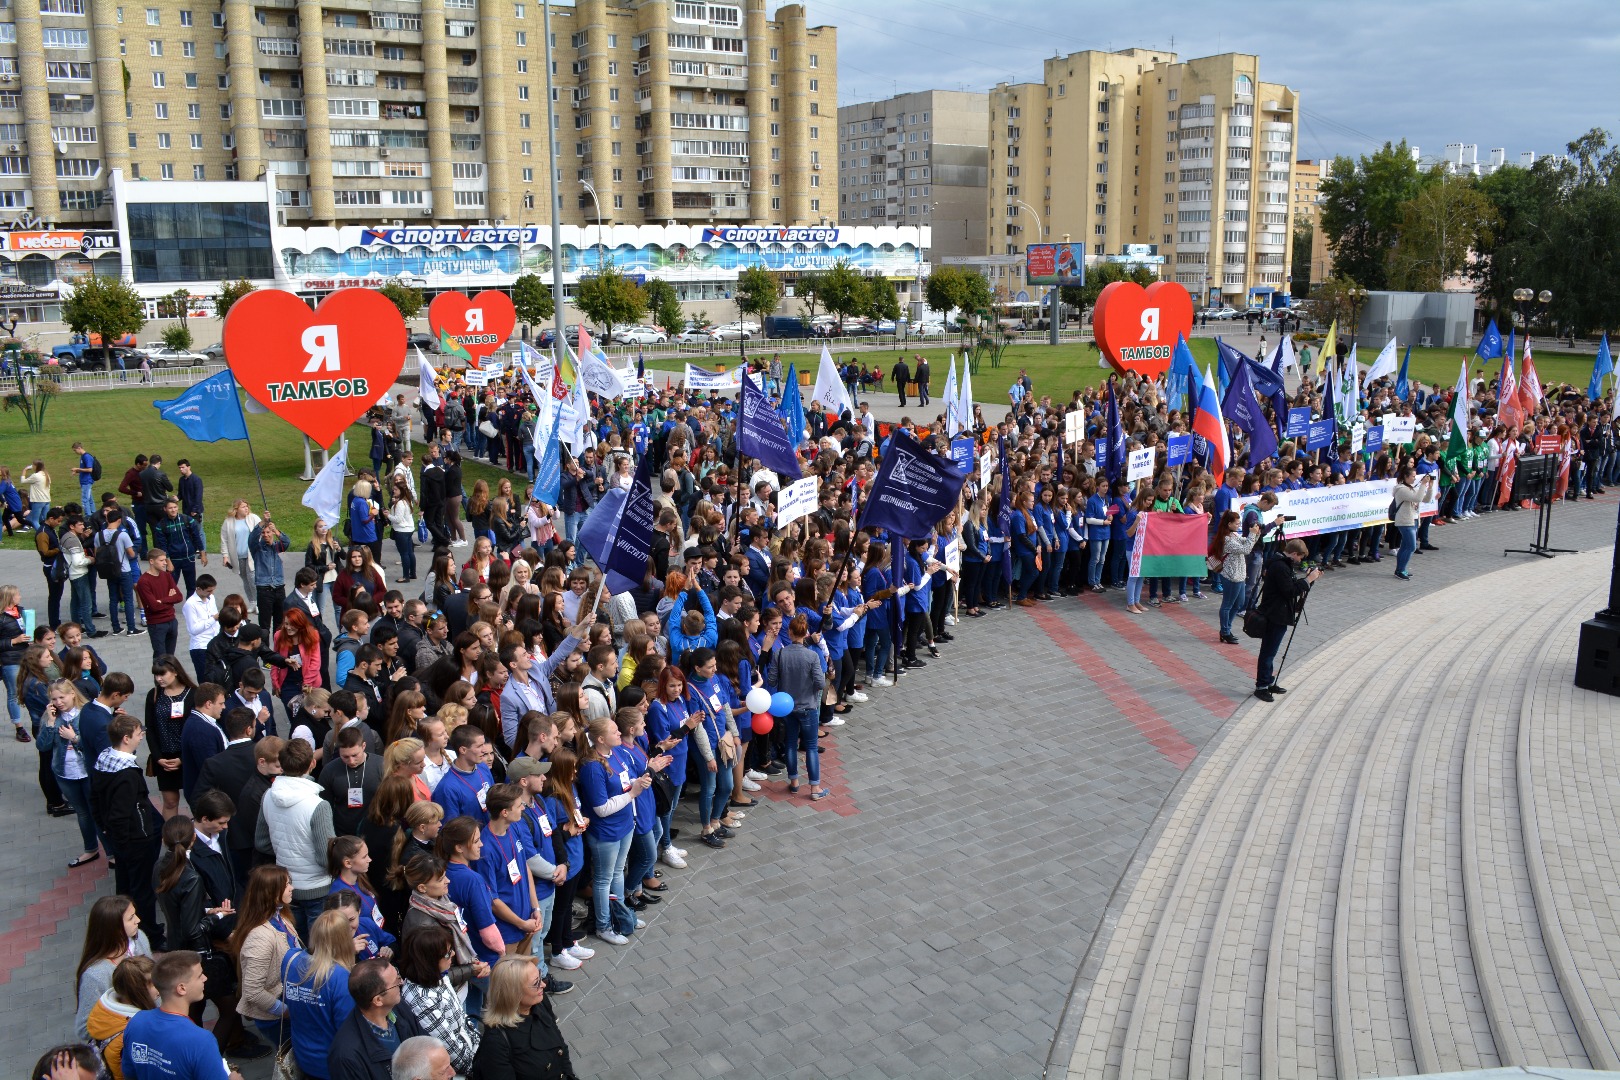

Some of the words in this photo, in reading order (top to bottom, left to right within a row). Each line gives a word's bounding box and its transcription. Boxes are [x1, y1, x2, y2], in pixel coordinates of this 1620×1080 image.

[18, 233, 80, 249] мебель
[305, 280, 335, 289] ОЧКИ
[338, 279, 361, 288] ДЛЯ
[362, 278, 383, 287] ВАС
[465, 308, 484, 332] Я
[1139, 308, 1160, 341] Я
[301, 325, 341, 373] Я
[1120, 345, 1171, 361] ТАМБОВ
[267, 378, 369, 402] ТАМБОВ
[1310, 492, 1350, 503] РОССИЙСКОГО
[1350, 487, 1388, 497] СТУДЕНЧЕСТВА
[1283, 519, 1311, 529] МИРНОМУ
[1312, 514, 1346, 525] ФЕСТИВАЛЮ
